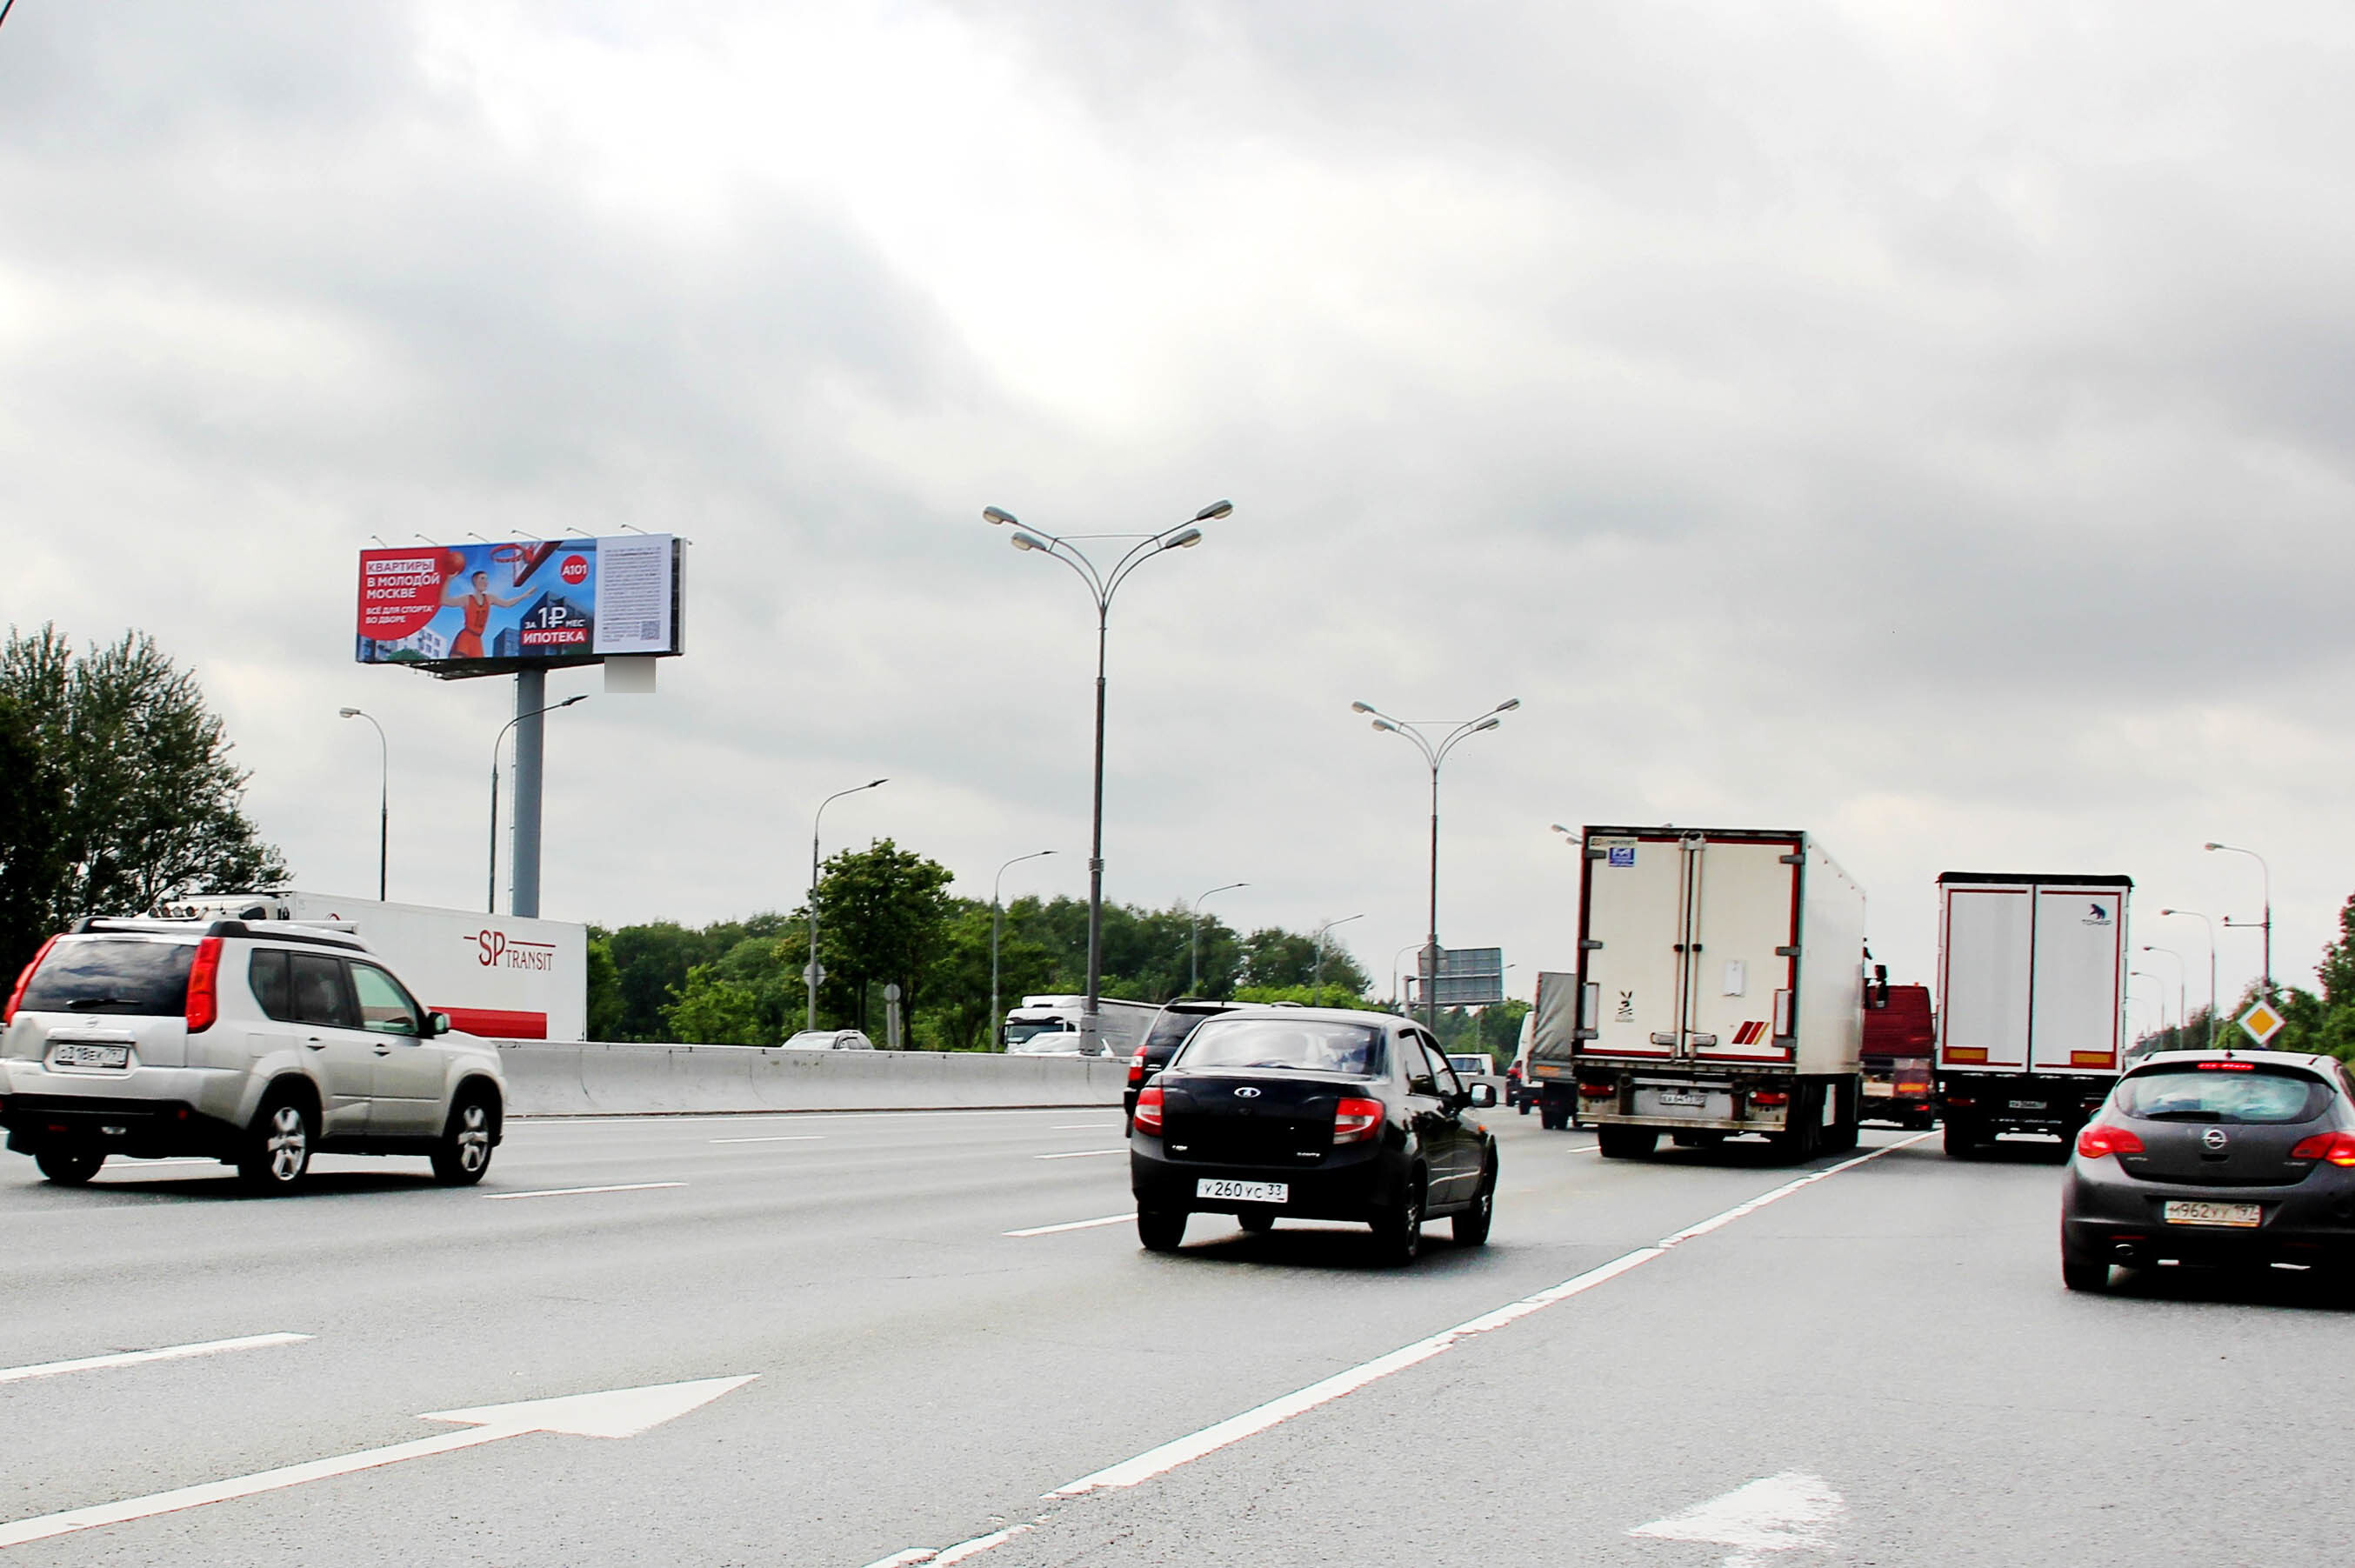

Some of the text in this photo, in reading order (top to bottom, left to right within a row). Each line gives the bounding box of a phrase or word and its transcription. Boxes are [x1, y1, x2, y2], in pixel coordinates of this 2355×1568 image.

[367, 561, 433, 573] КВАРТИРЫ
[367, 571, 440, 588] В МОЛОДОЙ
[366, 587, 417, 599] МОСКВЕ
[383, 606, 400, 615] ДЛЯ
[378, 615, 406, 624] ДВОРЕ
[524, 631, 585, 644] ИПОТЕКА
[478, 930, 553, 971] SP TRANSIT
